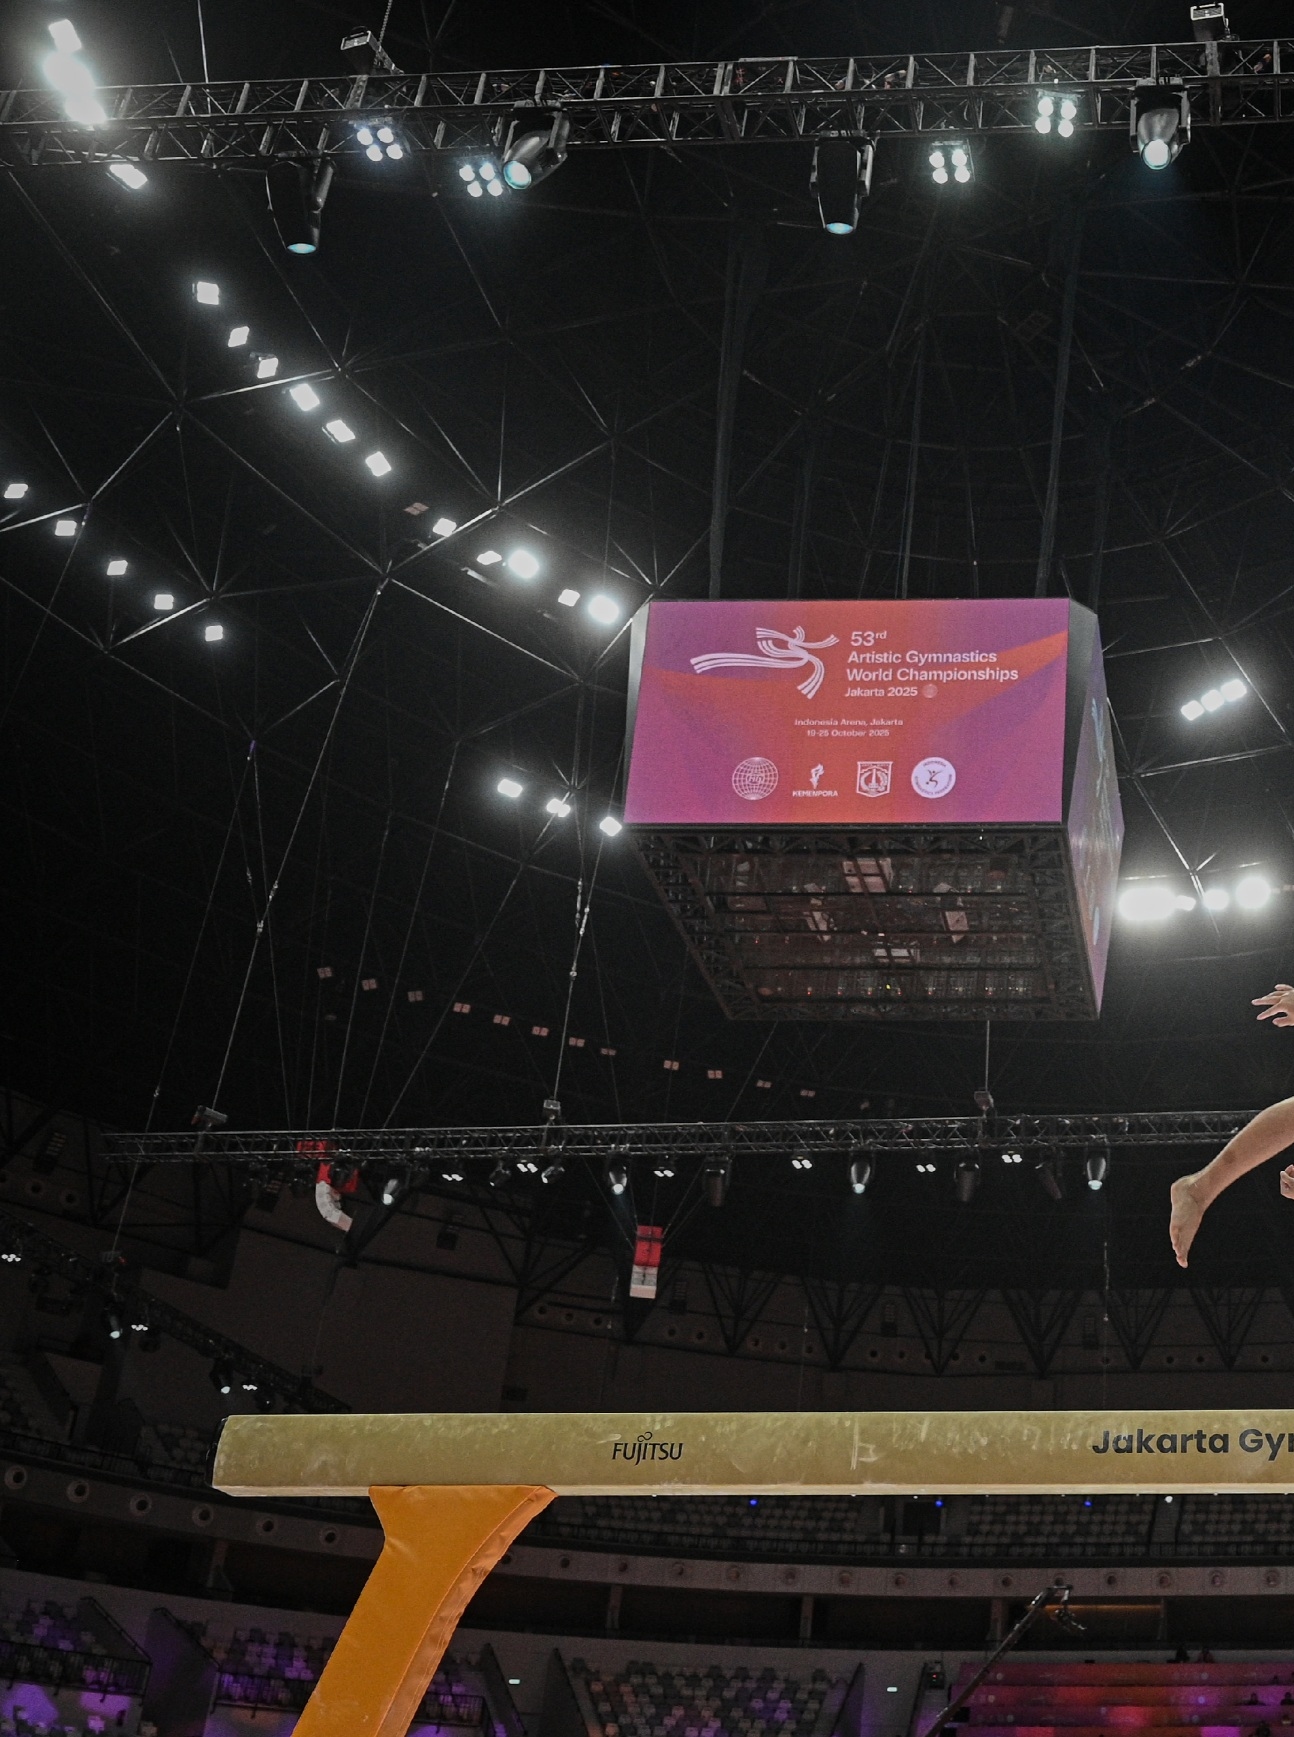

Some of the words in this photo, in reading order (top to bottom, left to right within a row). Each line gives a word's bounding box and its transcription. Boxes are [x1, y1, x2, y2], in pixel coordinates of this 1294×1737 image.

[851, 631, 888, 647] 53rd
[848, 651, 902, 664] Artistic
[906, 650, 998, 666] Gymnastics
[847, 668, 893, 681] World
[896, 667, 1019, 683] Championships
[845, 687, 885, 697] Jakarta
[887, 686, 918, 697] 2025
[612, 1431, 684, 1466] FUJITSU
[1091, 1428, 1230, 1454] Jakarta
